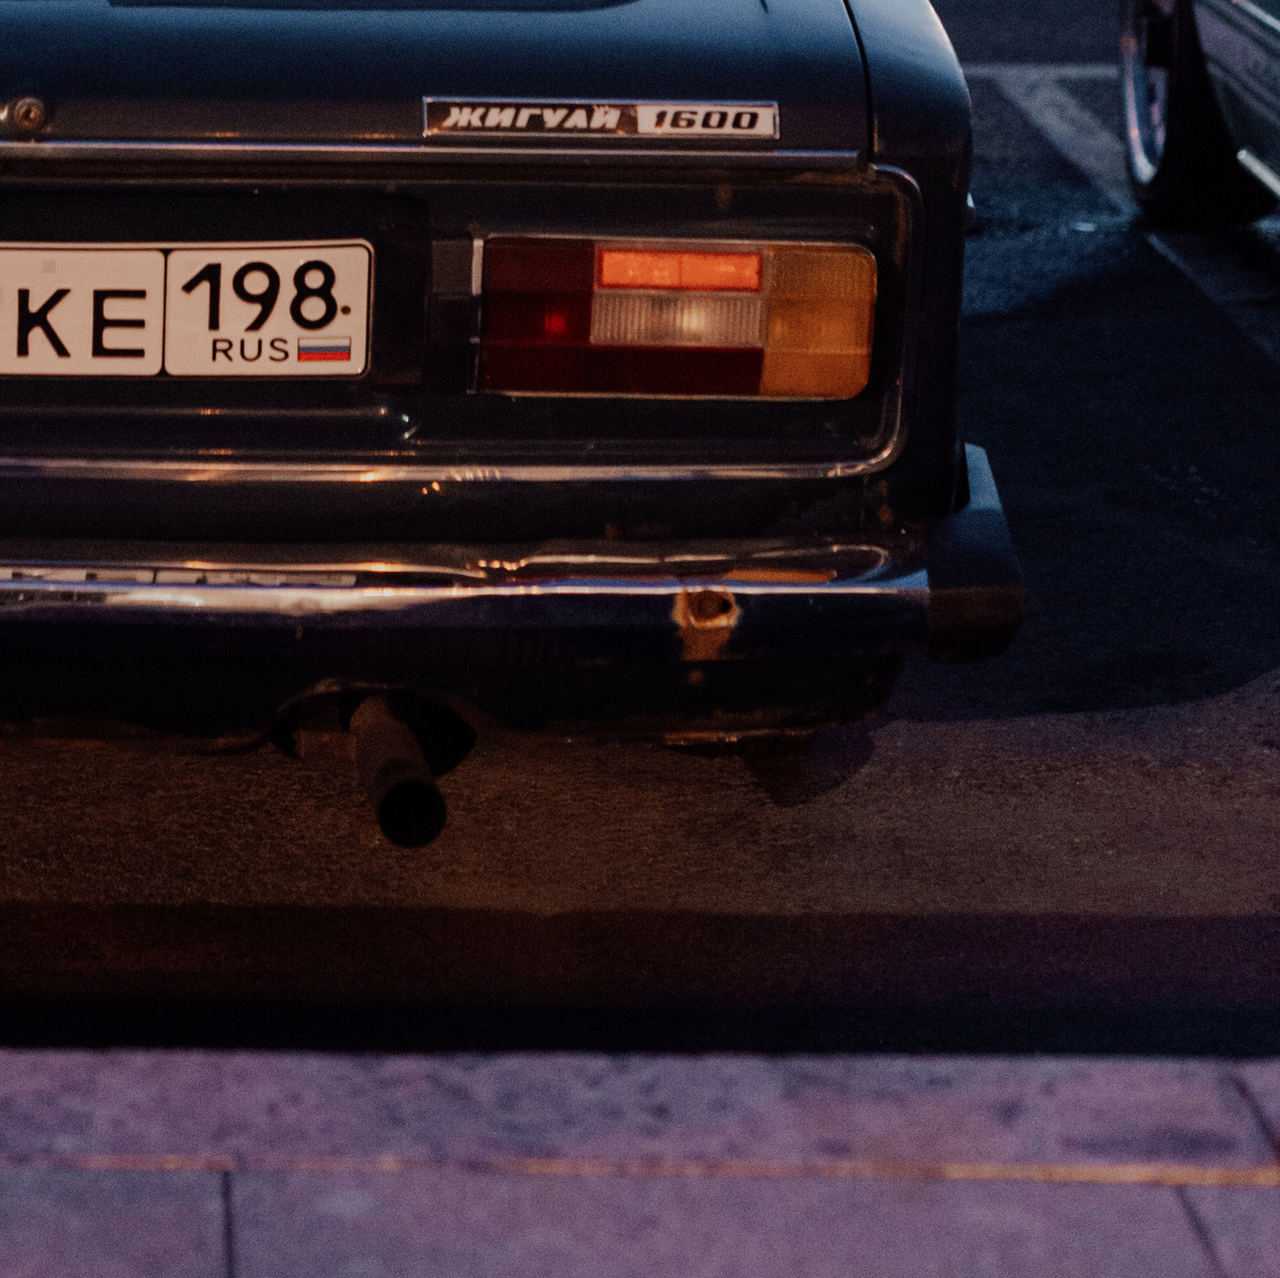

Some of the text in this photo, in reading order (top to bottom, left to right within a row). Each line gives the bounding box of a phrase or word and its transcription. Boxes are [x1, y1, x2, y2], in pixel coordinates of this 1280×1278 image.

[442, 105, 760, 130] ЖИГУЛИ 1600
[181, 259, 338, 332] 198
[211, 337, 289, 362] RUS
